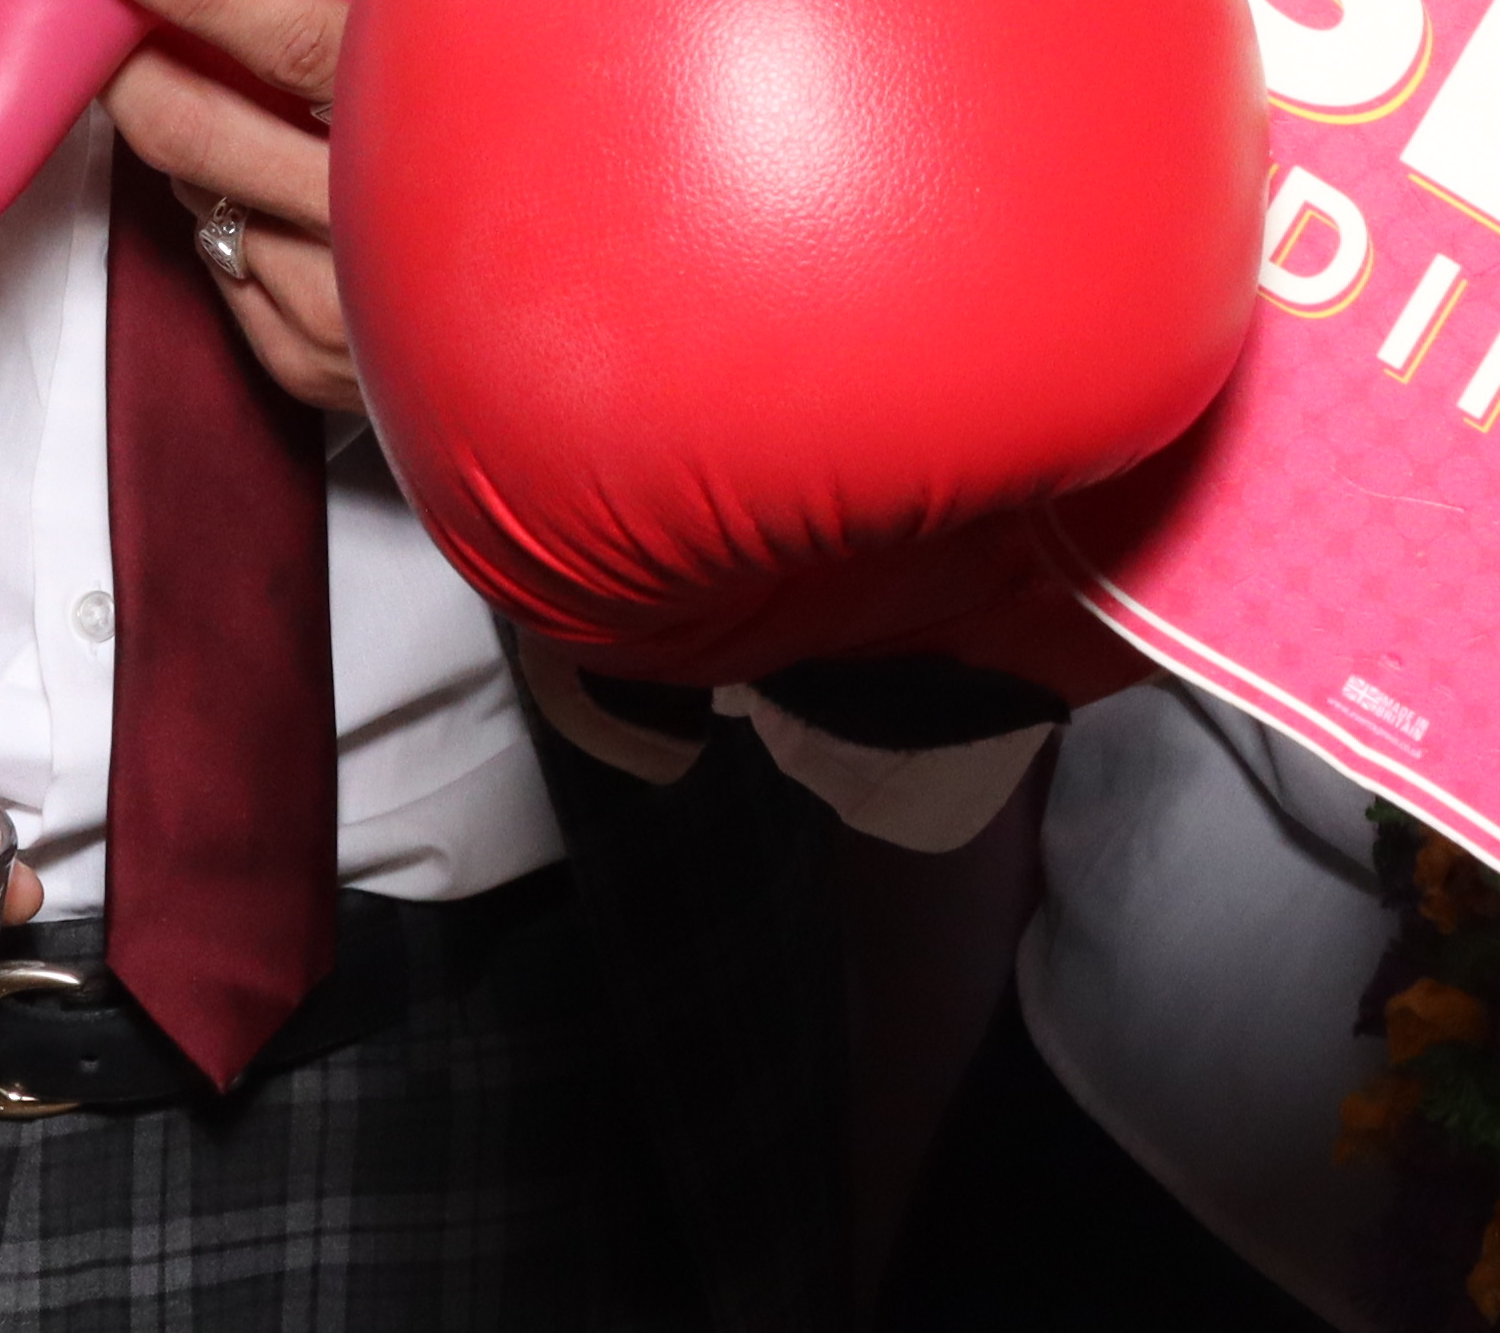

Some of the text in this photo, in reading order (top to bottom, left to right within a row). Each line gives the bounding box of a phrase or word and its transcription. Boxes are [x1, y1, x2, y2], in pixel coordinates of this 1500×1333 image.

[1376, 253, 1467, 383] I
[1374, 705, 1424, 742] BRITAIN
[1379, 694, 1430, 733] MADE IN
